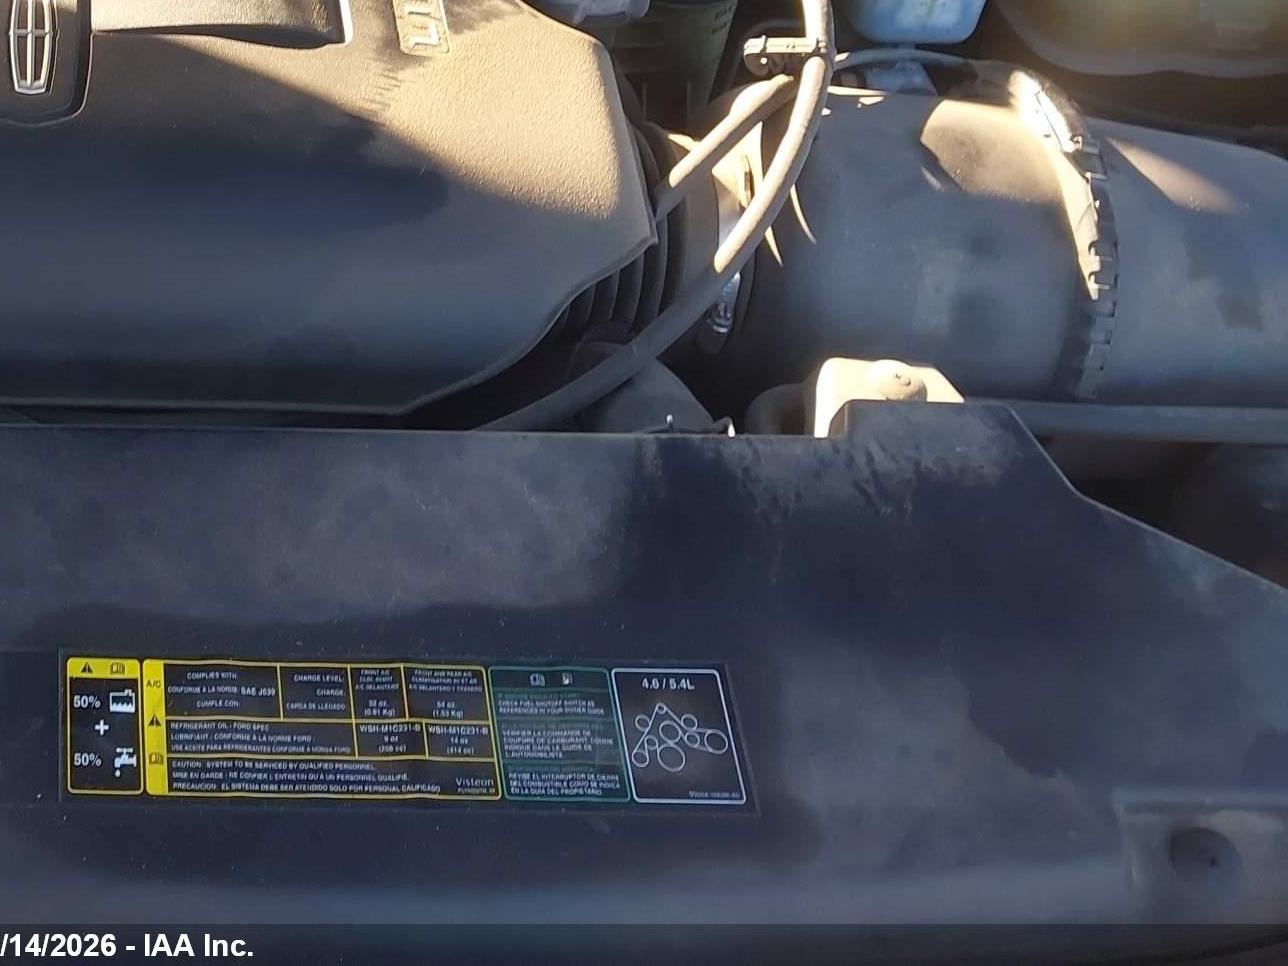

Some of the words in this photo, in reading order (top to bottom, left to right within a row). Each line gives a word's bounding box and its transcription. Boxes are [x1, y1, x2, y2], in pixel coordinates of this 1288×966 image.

[146, 679, 161, 689] A/C
[642, 677, 660, 690] 4.6
[669, 677, 695, 690] 5.4L
[73, 695, 101, 708] 50%
[73, 752, 102, 766] 50%
[455, 777, 494, 787] Visteon
